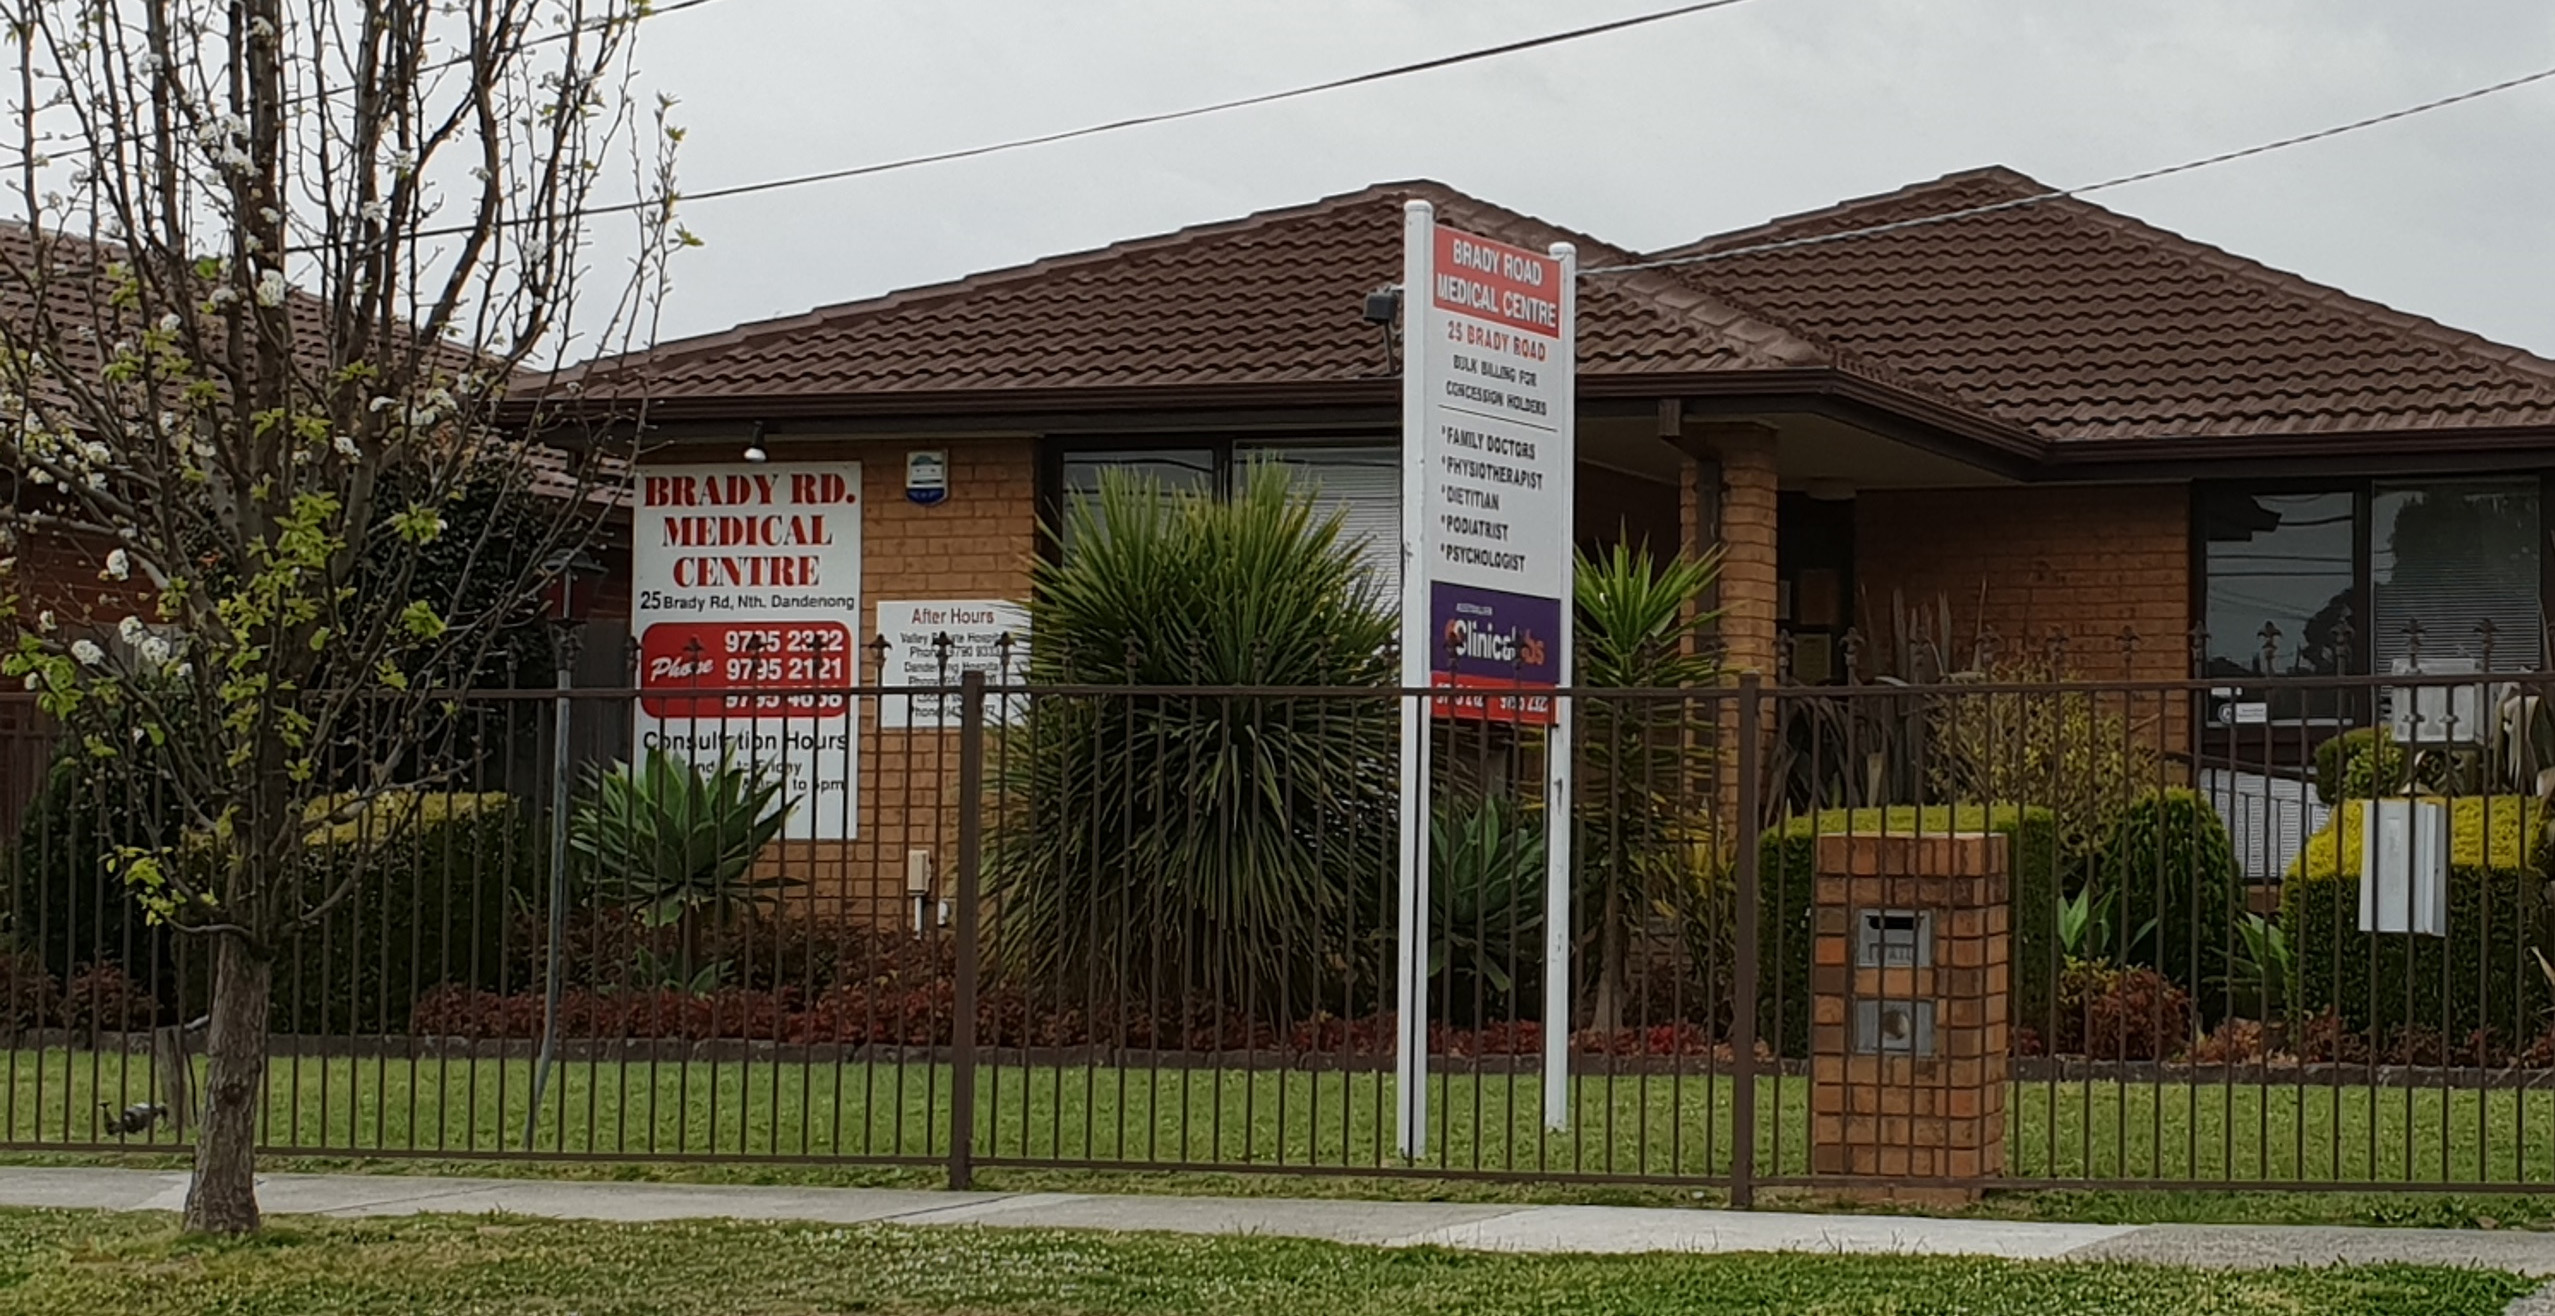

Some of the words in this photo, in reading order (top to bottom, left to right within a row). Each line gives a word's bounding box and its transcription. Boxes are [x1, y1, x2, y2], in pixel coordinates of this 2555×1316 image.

[1453, 239, 1500, 273] BRADY
[1504, 253, 1543, 287] ROAD
[1437, 273, 1499, 313] MEDICAL
[1503, 291, 1557, 328] CENTRE
[1448, 320, 1462, 342] 25
[1467, 325, 1510, 353] BRADY
[1513, 336, 1546, 362] ROAD
[1486, 434, 1536, 461] DOCTORS
[644, 474, 779, 506] BRADY
[791, 472, 856, 505] RD.
[1446, 457, 1544, 491] PHYSIOTHERAPIST
[662, 514, 833, 547] MEDICAL
[1446, 515, 1509, 541] PODIATRIST
[673, 555, 820, 588] CENTRE
[1446, 544, 1526, 572] PSYCHOLOGIST
[640, 590, 662, 610] 25
[664, 595, 706, 612] Brady
[710, 595, 735, 611] Rd,
[738, 595, 767, 609] Nth.
[771, 594, 855, 611] Dandenong
[911, 608, 947, 625] After
[951, 608, 995, 624] Hours
[787, 658, 842, 680] 2121
